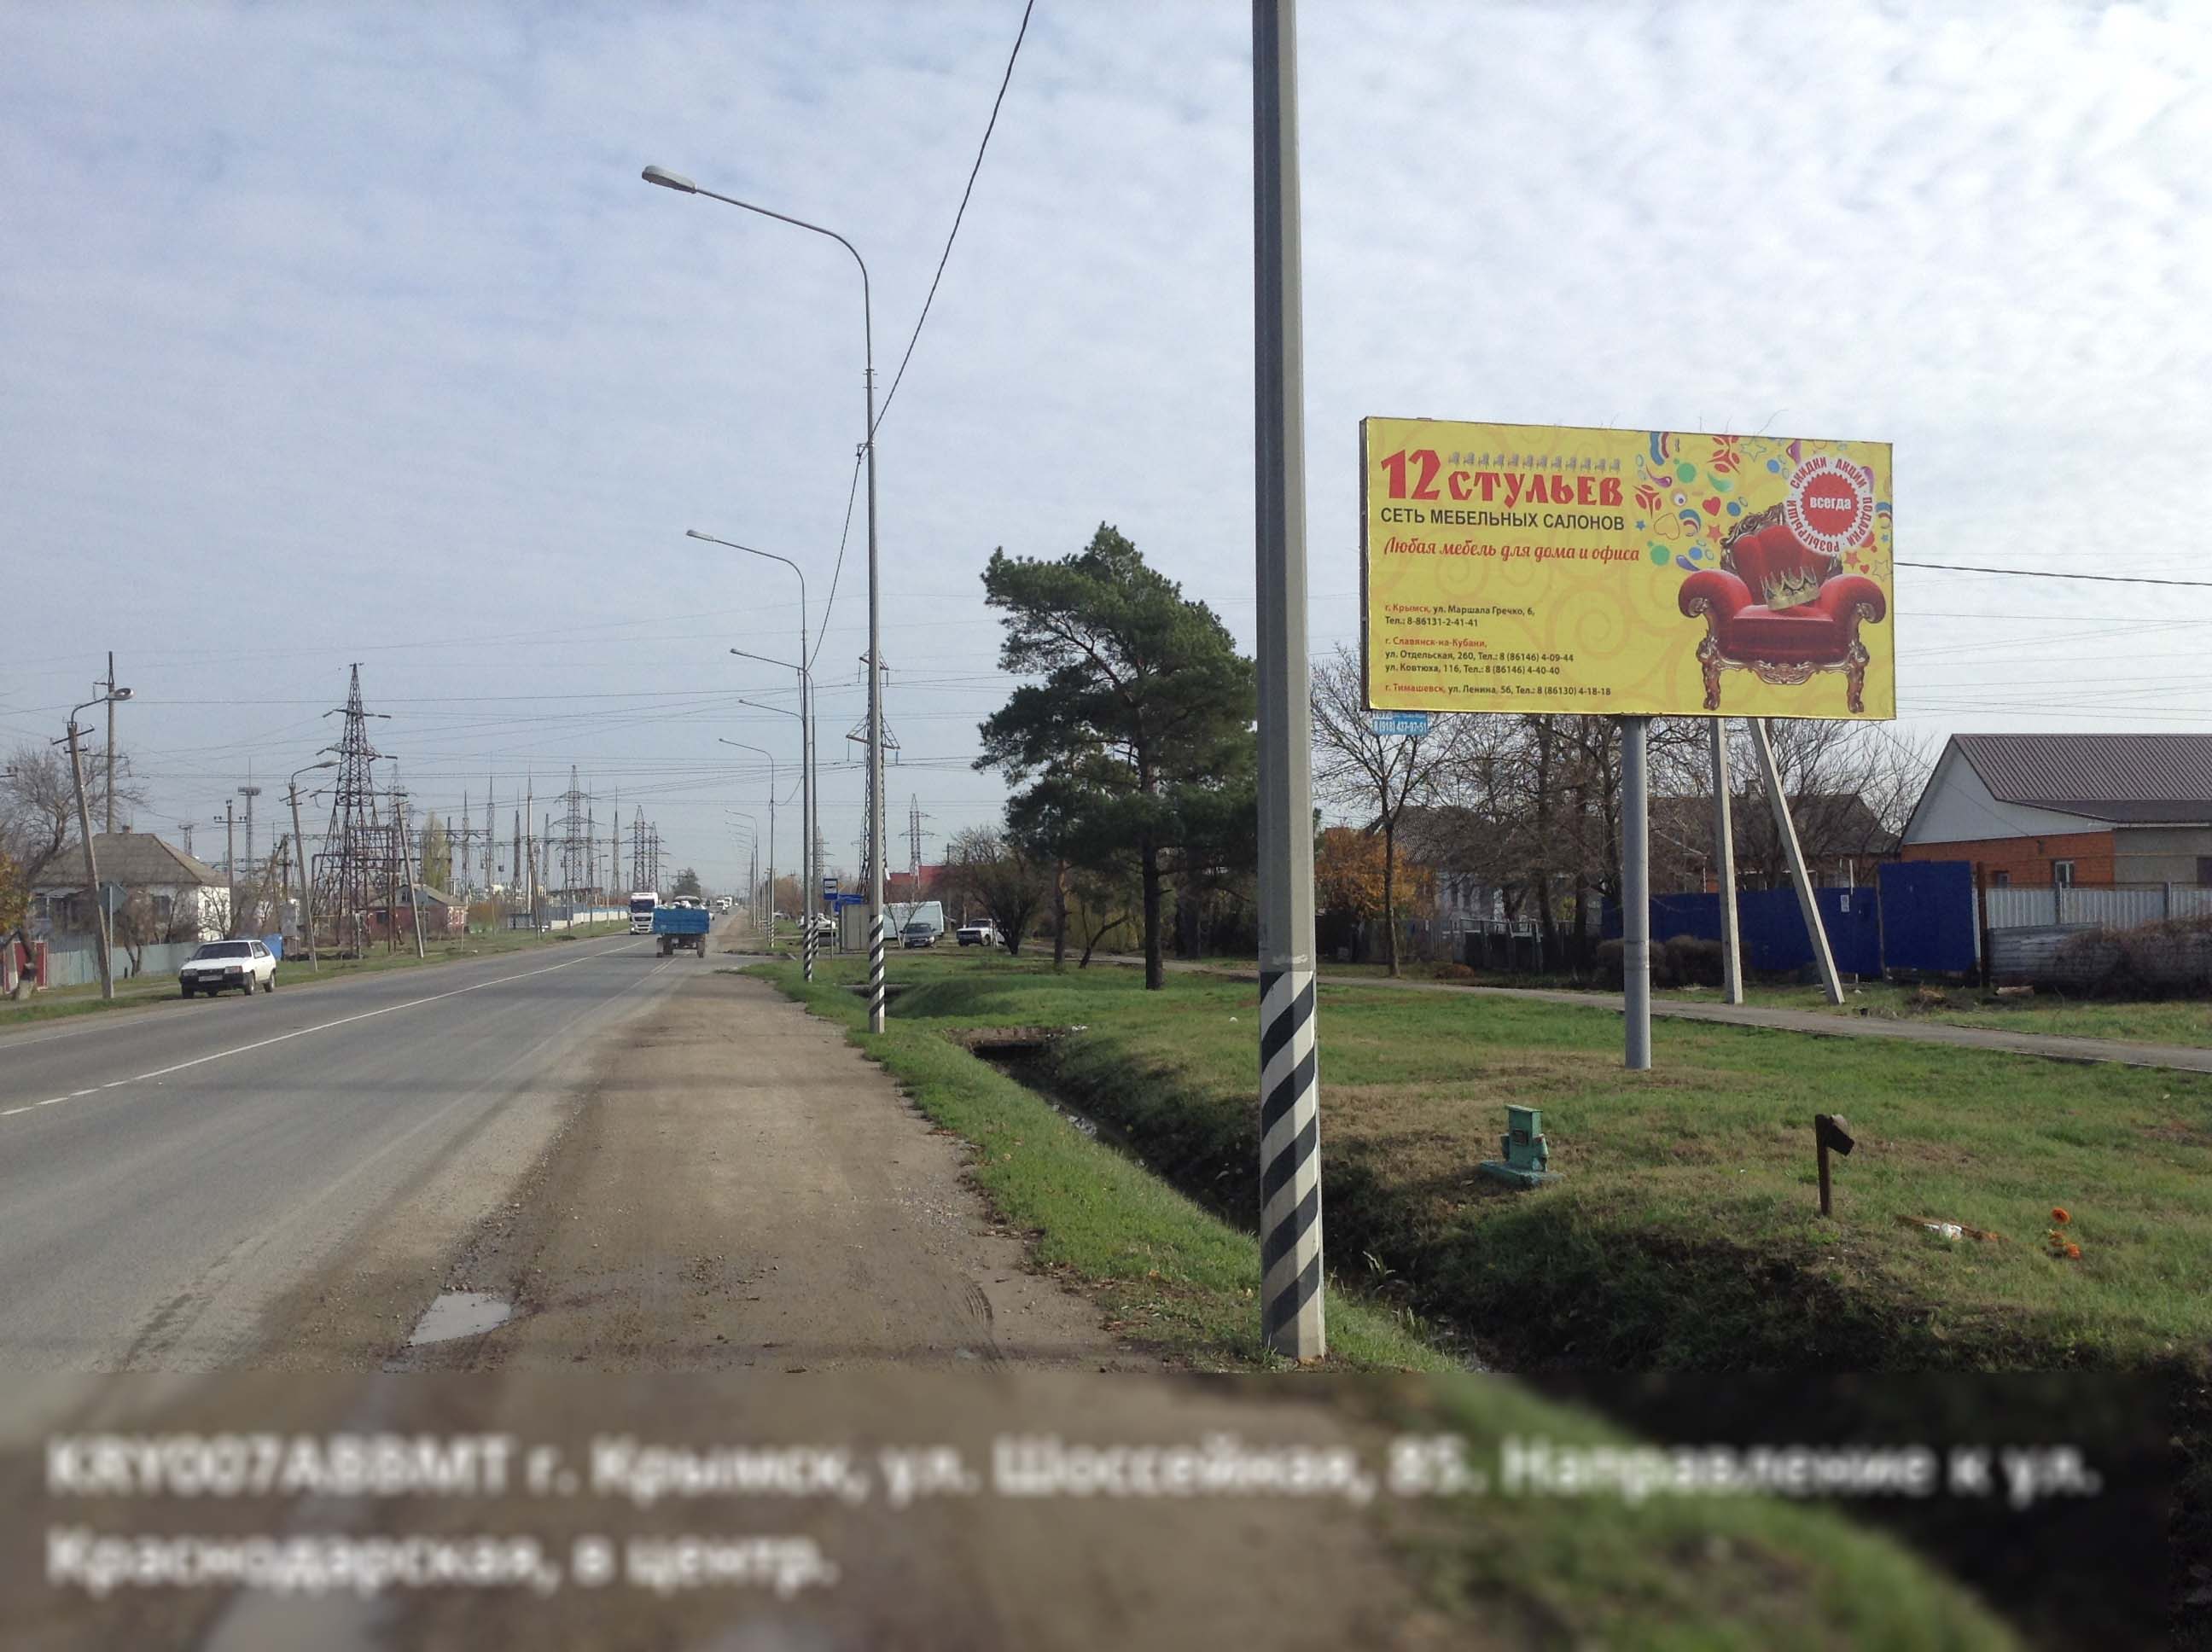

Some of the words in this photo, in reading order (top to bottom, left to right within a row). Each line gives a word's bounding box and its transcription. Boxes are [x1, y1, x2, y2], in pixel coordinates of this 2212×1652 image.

[1381, 449, 1441, 501] 12
[1447, 469, 1625, 509] СТУЛЬЕВ
[1790, 457, 1827, 489] СКИДКИ
[1835, 458, 1867, 488] АКЦИИ
[1809, 497, 1851, 510] всегда
[1380, 507, 1425, 525] СЕТЬ
[1429, 508, 1540, 529] МЕБЕЛЬНЫХ
[1544, 512, 1626, 532] САЛОНОВ
[1786, 499, 1841, 553] РОЗЫГРЫШИ
[1847, 497, 1873, 547] ПОДАРКИ
[1383, 537, 1437, 556] Любая
[1440, 539, 1497, 557] мебель
[1499, 544, 1532, 562] для
[1534, 546, 1576, 563] дома
[1579, 549, 1589, 560] и
[1591, 544, 1640, 565] офиса
[1385, 616, 1406, 625] Тел.:
[1406, 617, 1478, 626] 8-86131-2-41-41
[1393, 603, 1431, 614] Крымск,
[1433, 606, 1446, 614] ул.
[1447, 605, 1490, 615] Маршала
[1492, 606, 1525, 616] Гречко,
[1385, 651, 1398, 660] ул.
[1400, 650, 1455, 660] Отдельская,
[1457, 652, 1476, 660] 260,
[1499, 652, 1505, 660] 8
[1507, 653, 1540, 662] (86146)
[1541, 654, 1574, 662] 4-09-44
[1385, 665, 1398, 673] ул.
[1400, 663, 1441, 673] Ковтюха,
[1444, 665, 1462, 673] 116,
[1485, 665, 1491, 673] 8
[1493, 666, 1526, 675] (86146)
[1528, 666, 1560, 675] 4-40-40
[1447, 685, 1460, 695] ул.
[1500, 686, 1513, 695] 56,
[1537, 686, 1543, 695] 8
[1545, 687, 1577, 696] (86130)
[1579, 688, 1611, 696] 4-18-18
